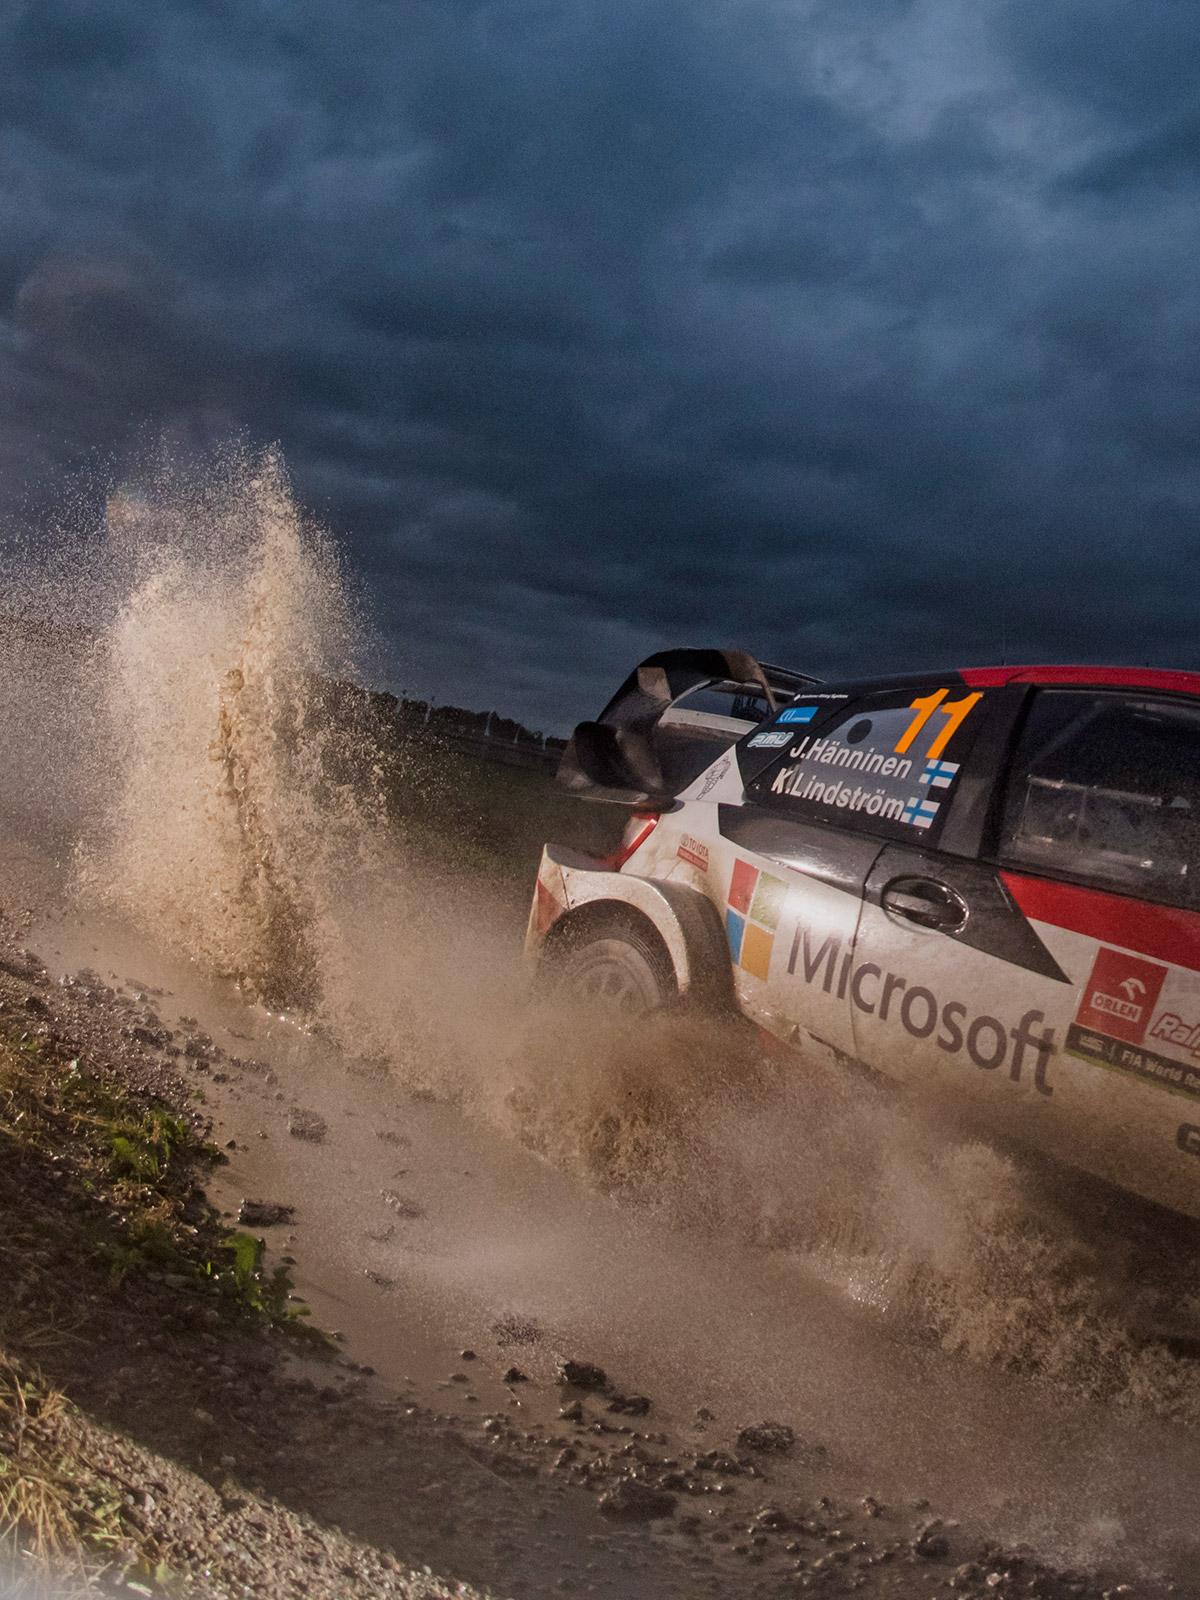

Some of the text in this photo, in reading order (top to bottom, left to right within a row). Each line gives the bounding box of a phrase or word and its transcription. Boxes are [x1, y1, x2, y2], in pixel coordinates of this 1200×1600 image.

[894, 688, 984, 759] 11
[790, 737, 912, 779] J.Hänninen
[771, 766, 905, 821] K.Lindström
[787, 921, 1057, 1096] Microsoft
[1094, 995, 1139, 1020] ORLEN
[1122, 1050, 1142, 1067] FIA
[1145, 1057, 1183, 1081] World
